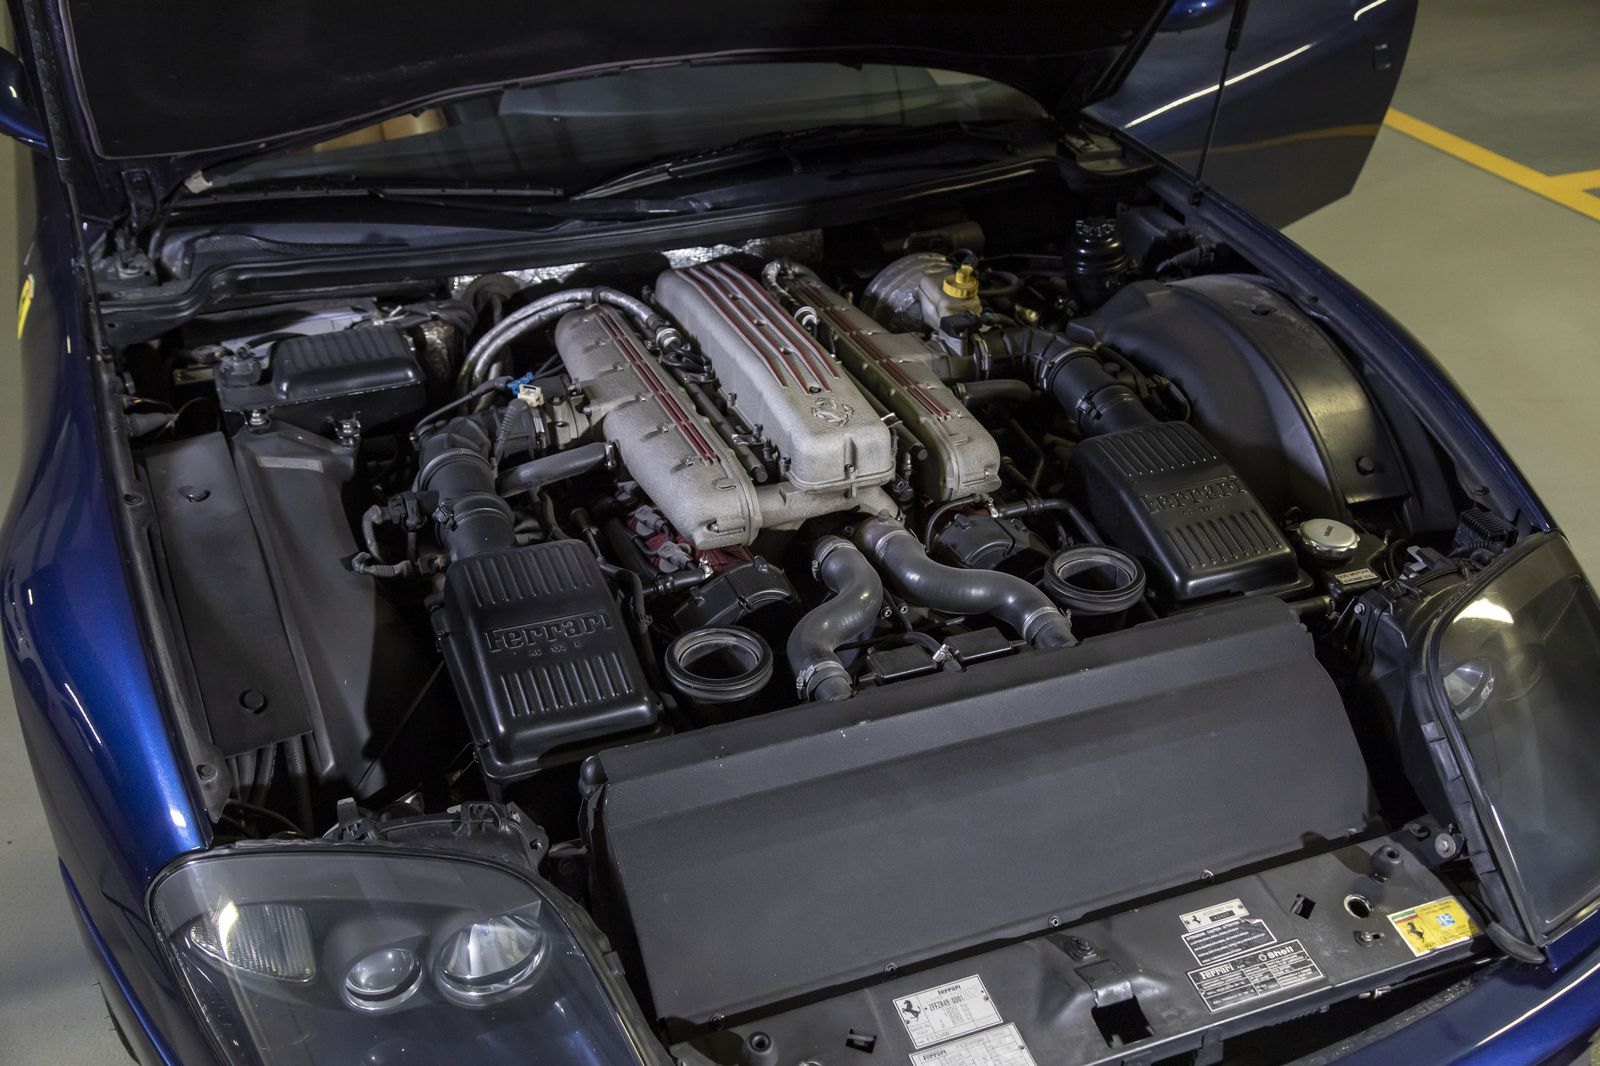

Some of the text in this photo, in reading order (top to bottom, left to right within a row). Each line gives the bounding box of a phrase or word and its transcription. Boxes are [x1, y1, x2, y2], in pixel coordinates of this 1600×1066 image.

[1141, 475, 1248, 514] Ferrari
[484, 609, 614, 653] Ferrari
[1266, 946, 1295, 959] Shell
[1199, 963, 1235, 980] Ferrari
[937, 984, 961, 996] Ferrari
[922, 1049, 947, 1061] Ferrari
